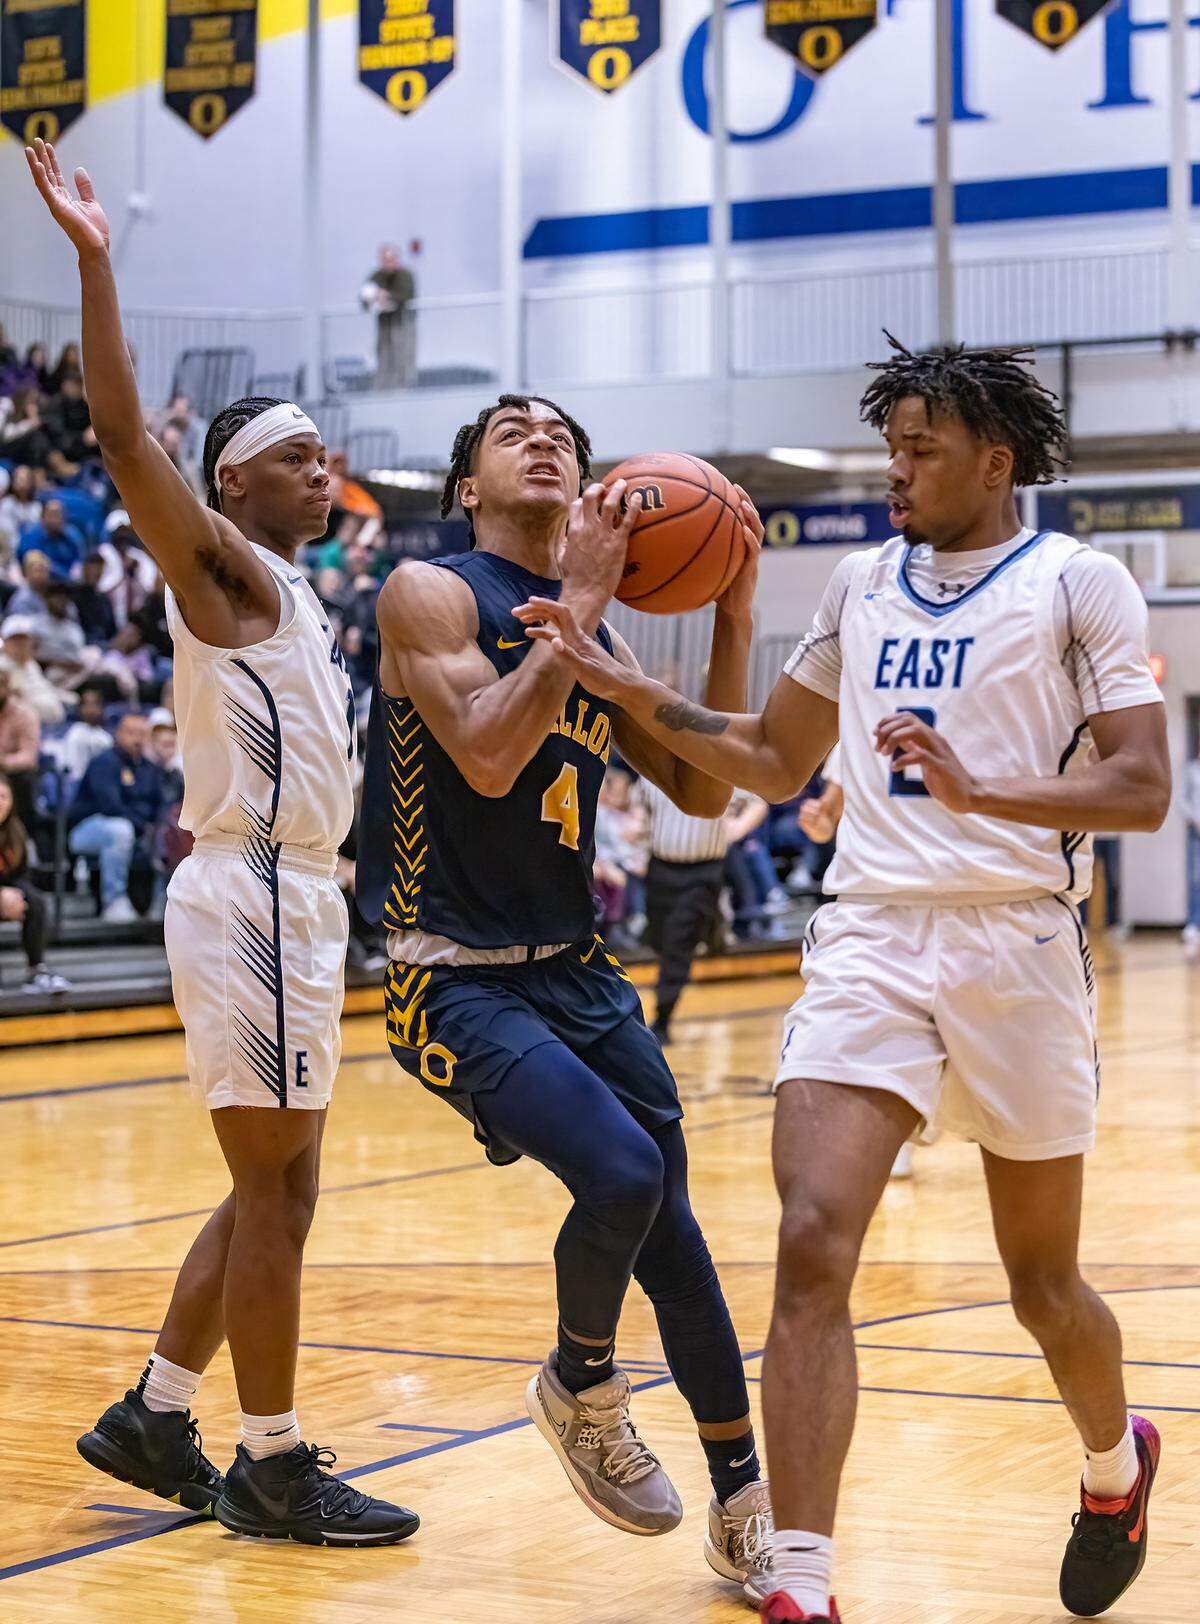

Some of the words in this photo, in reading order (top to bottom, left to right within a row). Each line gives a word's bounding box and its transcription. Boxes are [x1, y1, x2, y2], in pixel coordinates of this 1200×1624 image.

[1031, 0, 1078, 45] O
[587, 47, 632, 90] O
[798, 25, 843, 69] O
[385, 69, 428, 112] O
[189, 93, 227, 136] O
[873, 636, 976, 690] EAST
[541, 762, 580, 851] 4
[296, 1051, 309, 1088] E
